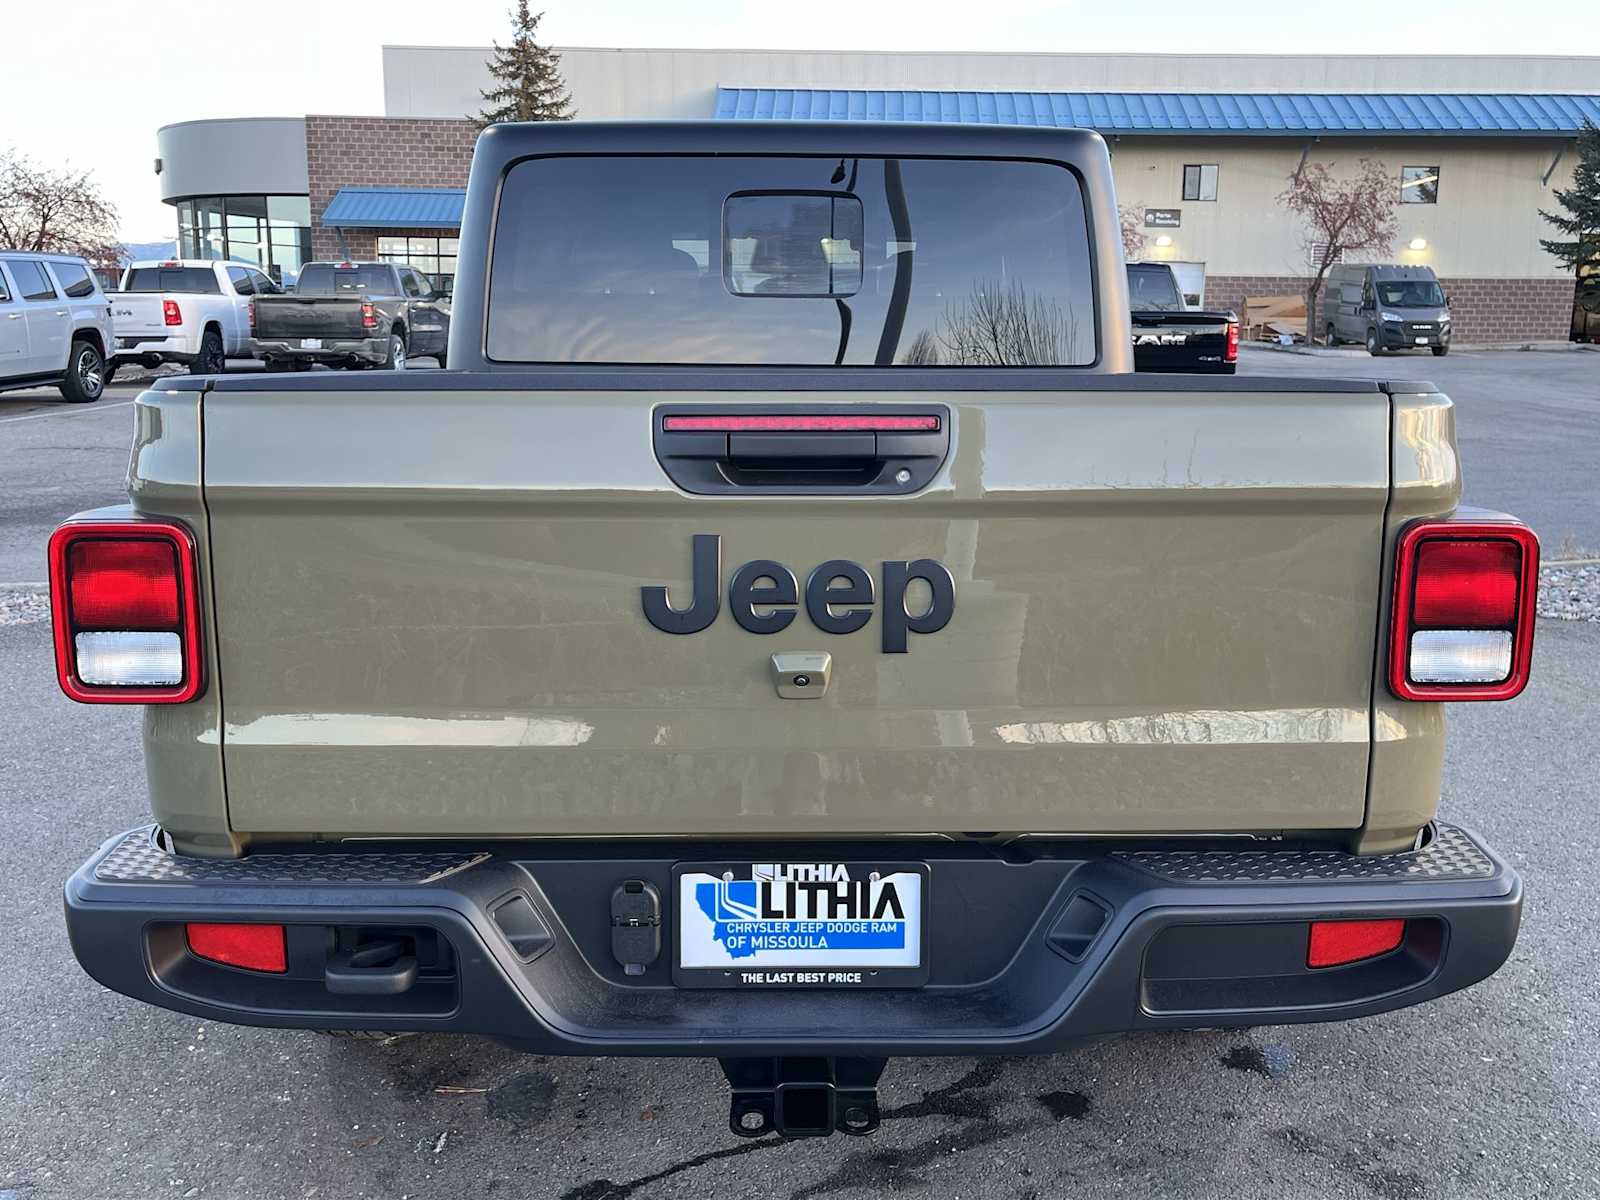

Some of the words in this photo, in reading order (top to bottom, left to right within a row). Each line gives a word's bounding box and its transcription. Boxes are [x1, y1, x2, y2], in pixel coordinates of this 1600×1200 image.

[641, 534, 956, 653] Jeep
[774, 863, 851, 882] LITHIA
[761, 881, 905, 919] LITHIA
[727, 923, 790, 933] CHRYSLER
[794, 923, 824, 933] JEEP
[827, 923, 868, 933] DODGE
[871, 923, 897, 933] RAM
[727, 936, 747, 948] OF
[751, 936, 828, 948] MISSOULA
[741, 973, 764, 983] THE
[766, 973, 794, 983] LAST
[797, 973, 825, 983] BEST
[828, 973, 861, 983] PRICE
